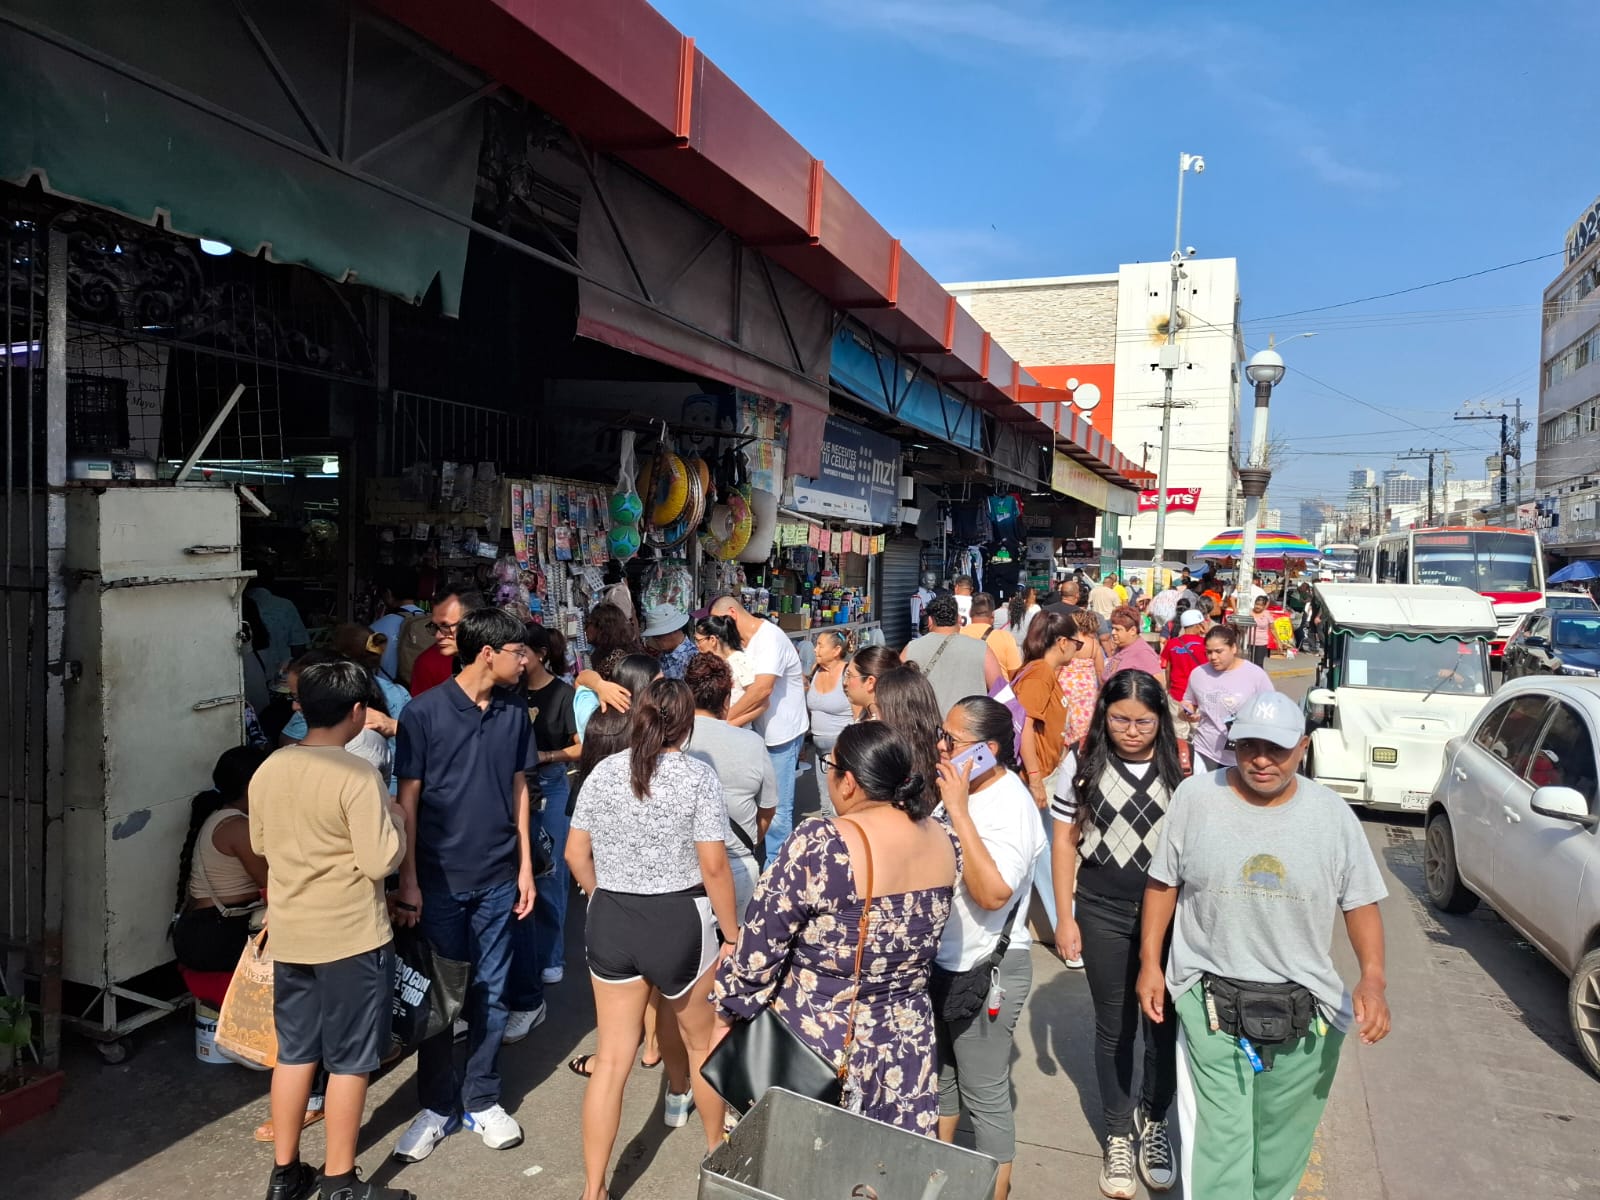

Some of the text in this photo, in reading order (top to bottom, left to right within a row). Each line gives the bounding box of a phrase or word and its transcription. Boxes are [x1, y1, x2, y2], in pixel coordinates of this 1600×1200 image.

[831, 455, 856, 471] CELULAR
[872, 458, 896, 486] mzt
[1256, 701, 1274, 720] NY
[409, 971, 431, 992] CON
